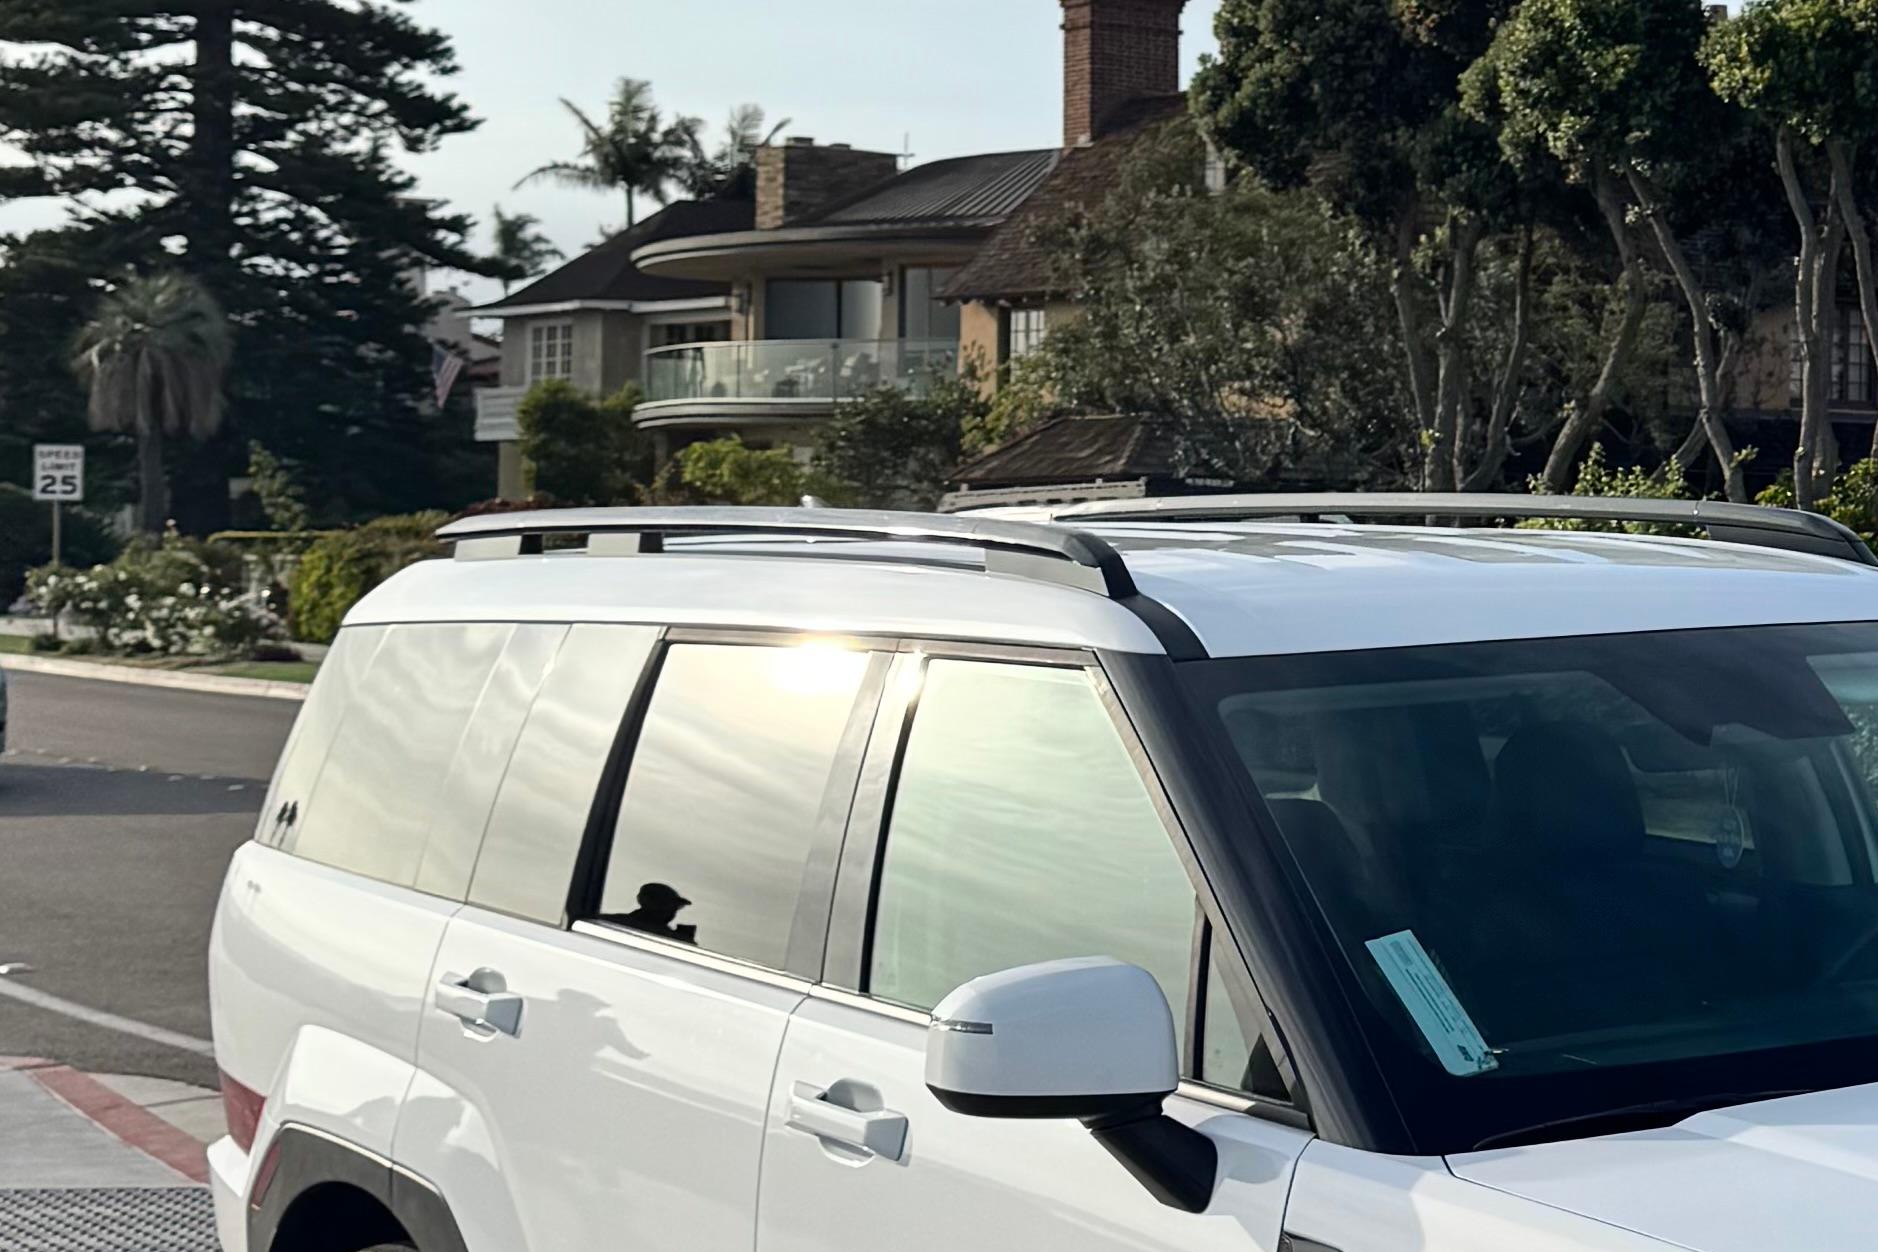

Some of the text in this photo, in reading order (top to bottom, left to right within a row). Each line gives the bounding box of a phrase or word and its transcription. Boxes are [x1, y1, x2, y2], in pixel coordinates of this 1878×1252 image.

[39, 450, 81, 460] SPEED
[41, 461, 76, 471] LIMIT
[40, 474, 77, 495] 25
